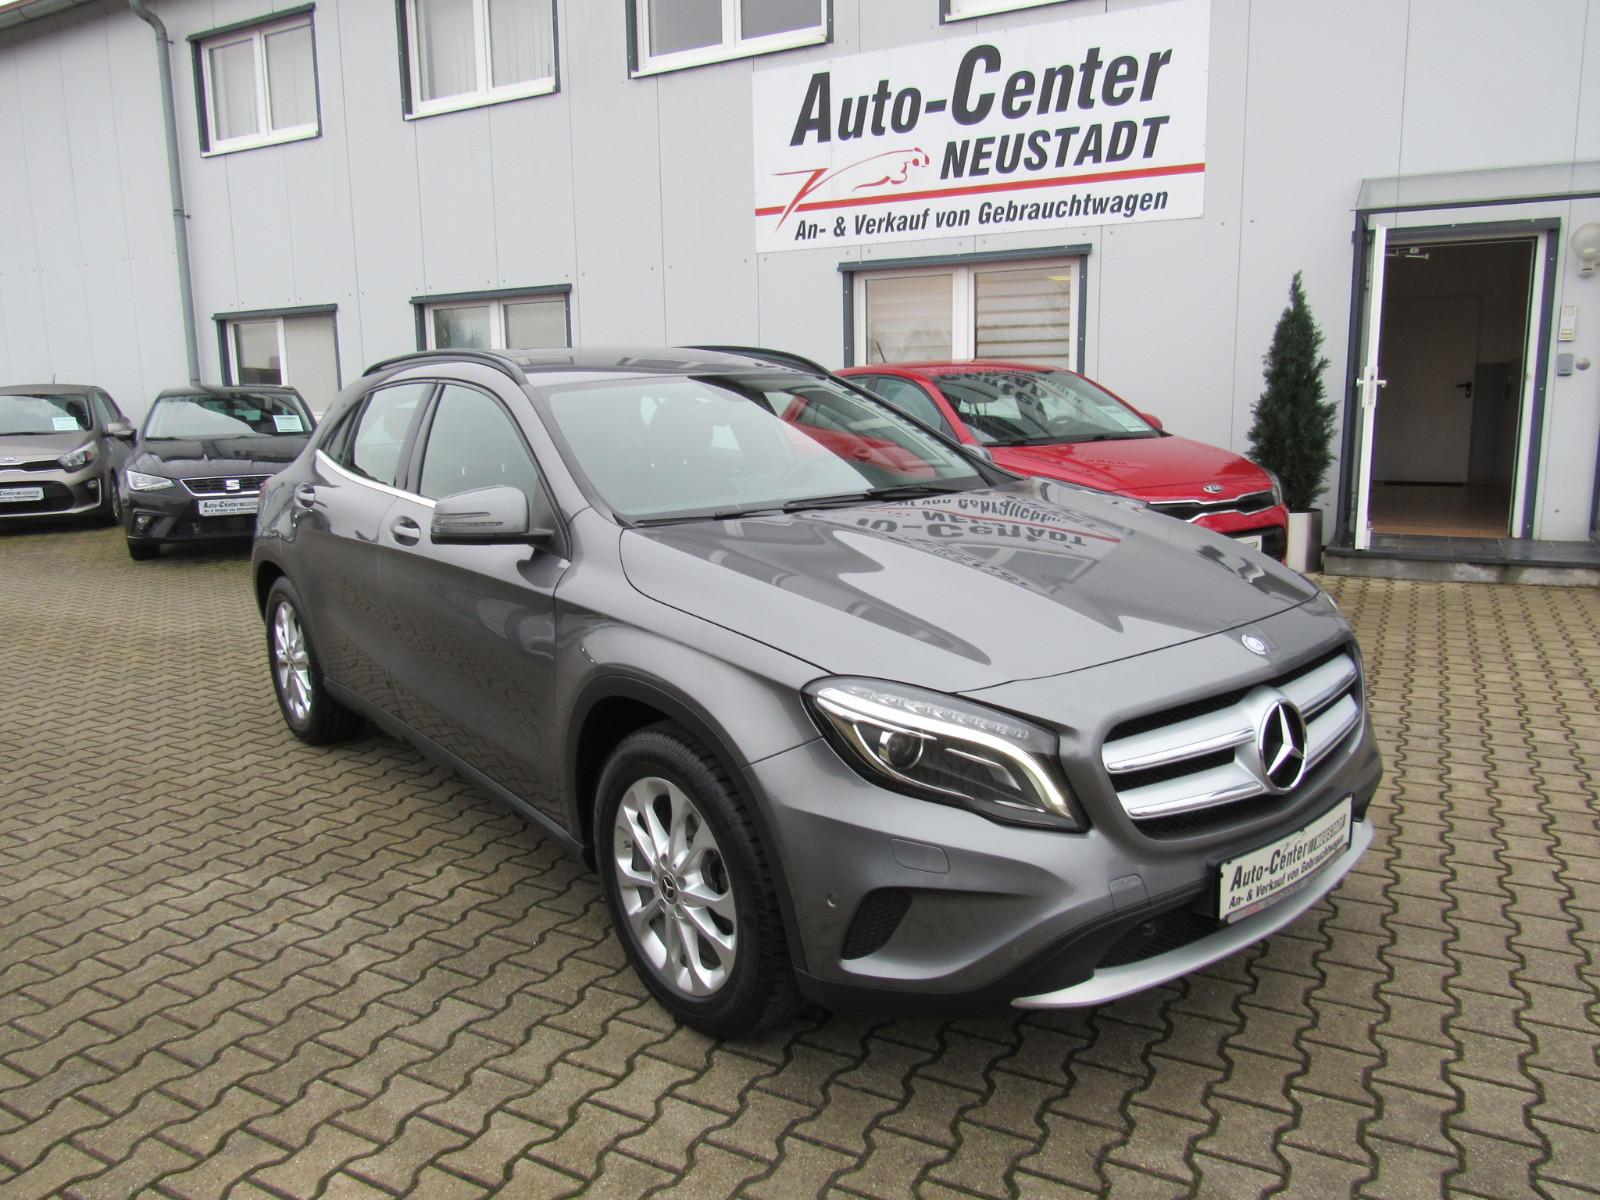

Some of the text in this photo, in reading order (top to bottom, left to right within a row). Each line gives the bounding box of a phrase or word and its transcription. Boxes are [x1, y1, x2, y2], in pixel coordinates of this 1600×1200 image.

[789, 44, 1173, 147] Auto-Center
[940, 115, 1170, 180] NEUSTADT
[794, 190, 1169, 241] An- & Verkauf von Gebrauchtwagen
[1230, 842, 1308, 892] Auto-Center
[1256, 873, 1286, 896] Verkauf
